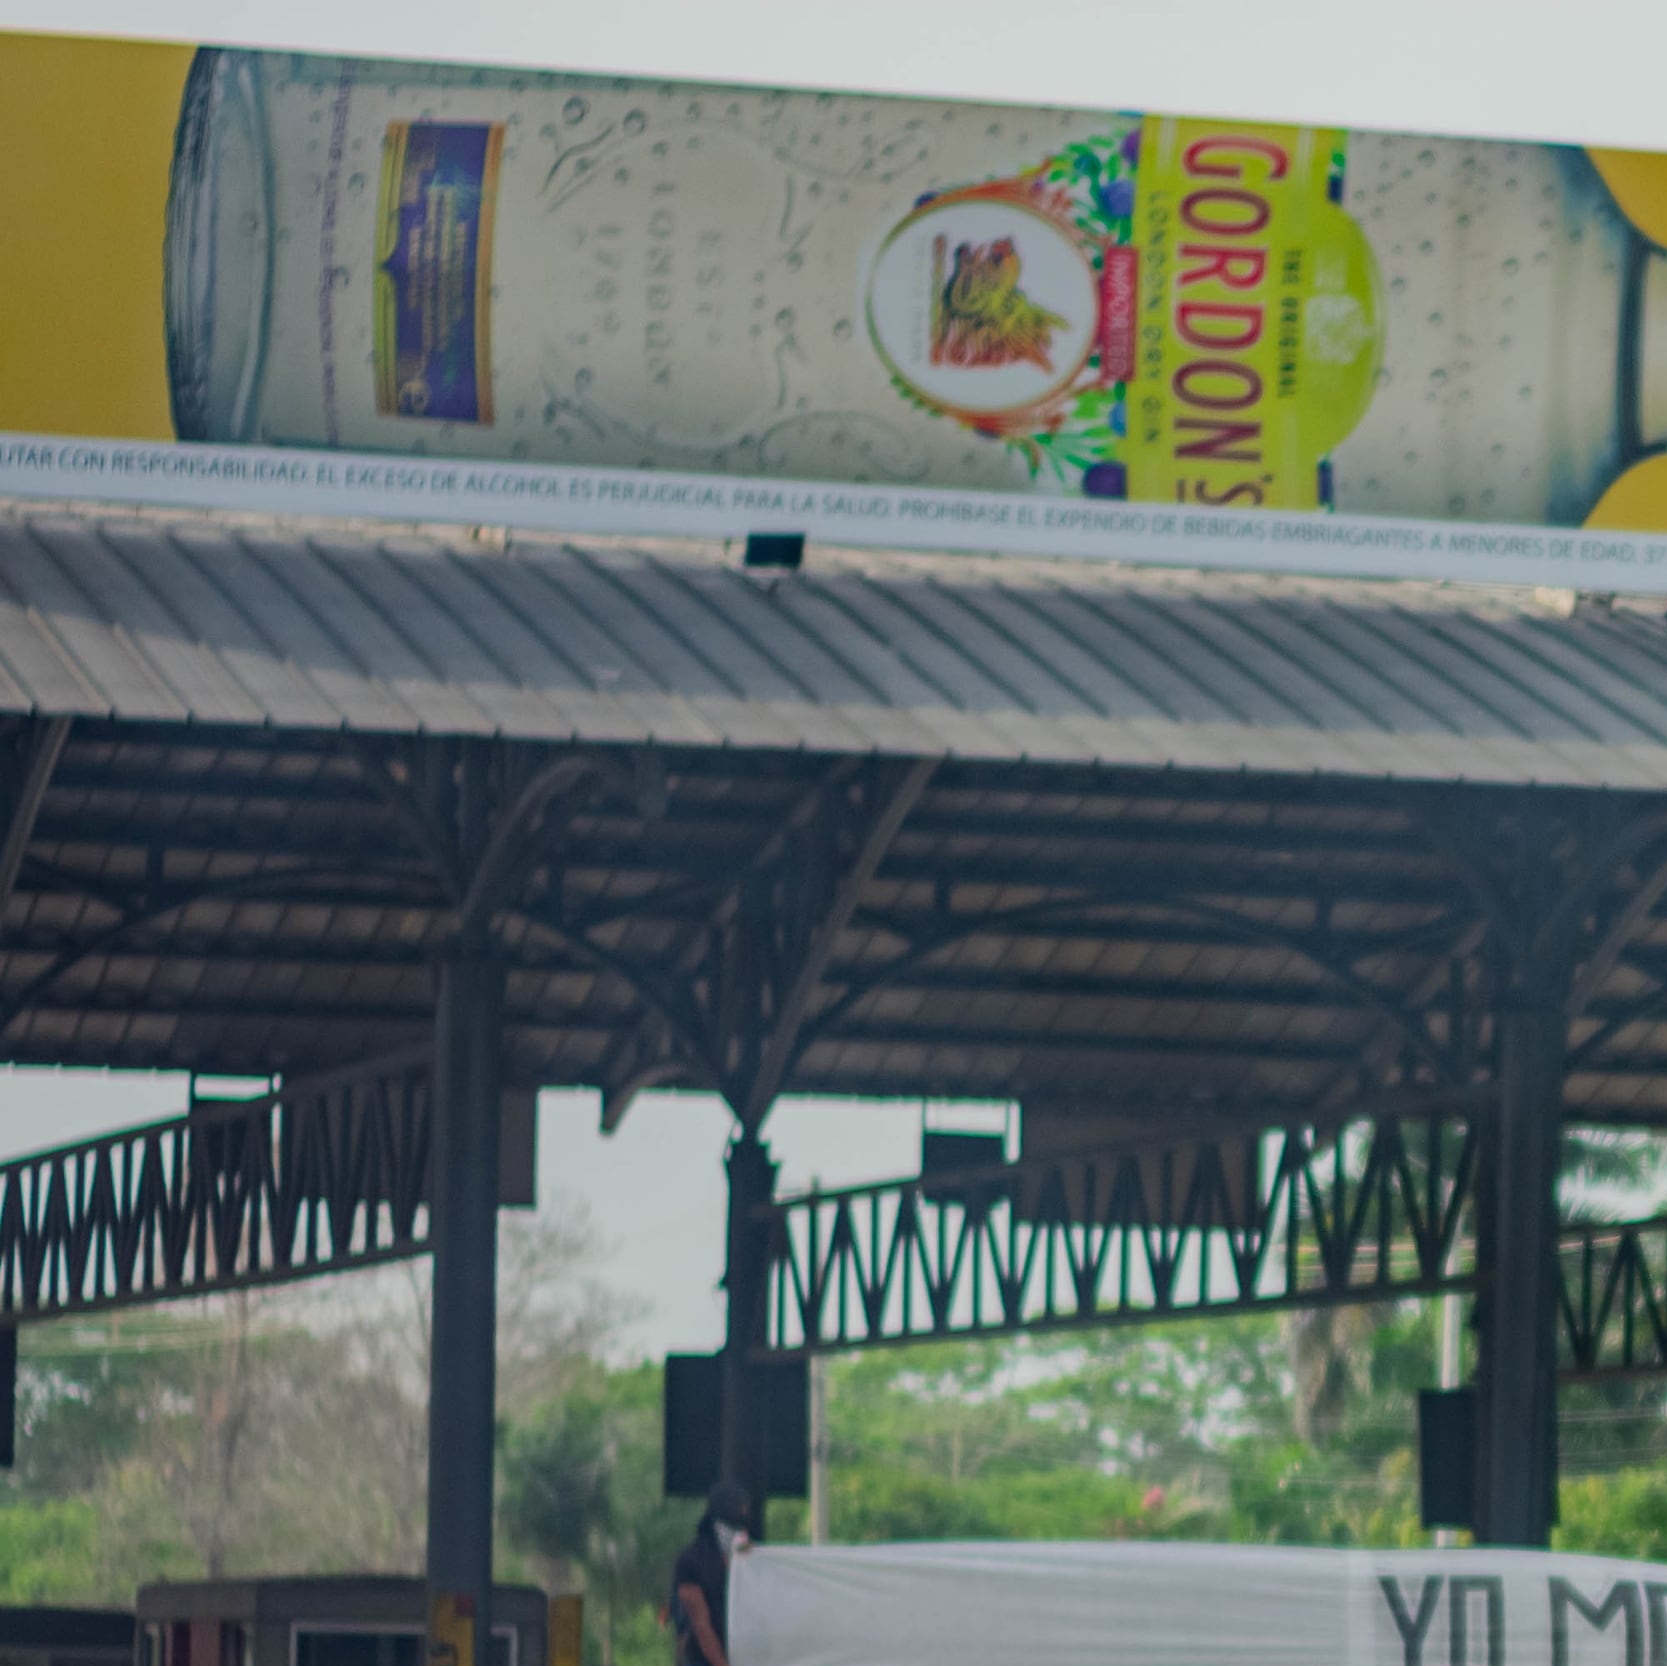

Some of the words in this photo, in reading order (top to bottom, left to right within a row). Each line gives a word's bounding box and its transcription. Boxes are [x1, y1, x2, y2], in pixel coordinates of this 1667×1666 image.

[1172, 134, 1290, 507] GORDON'S
[58, 446, 106, 473] CON
[315, 462, 336, 486] EL
[345, 465, 425, 491] EXCESO
[430, 470, 457, 492] DE
[464, 472, 558, 498] ALCOHOL
[568, 478, 592, 500] ES
[597, 480, 722, 508] PERJUDICIAL
[732, 488, 783, 511] PARA
[791, 492, 814, 513] LA
[1016, 505, 1038, 526] EL
[1044, 507, 1144, 533] EXPENDIO
[1150, 513, 1177, 534] DE
[1183, 515, 1266, 540] BEBIDAS
[1271, 521, 1425, 549] EMBRIAGANTES
[1448, 531, 1545, 557] MENORES
[1550, 538, 1575, 559] DE
